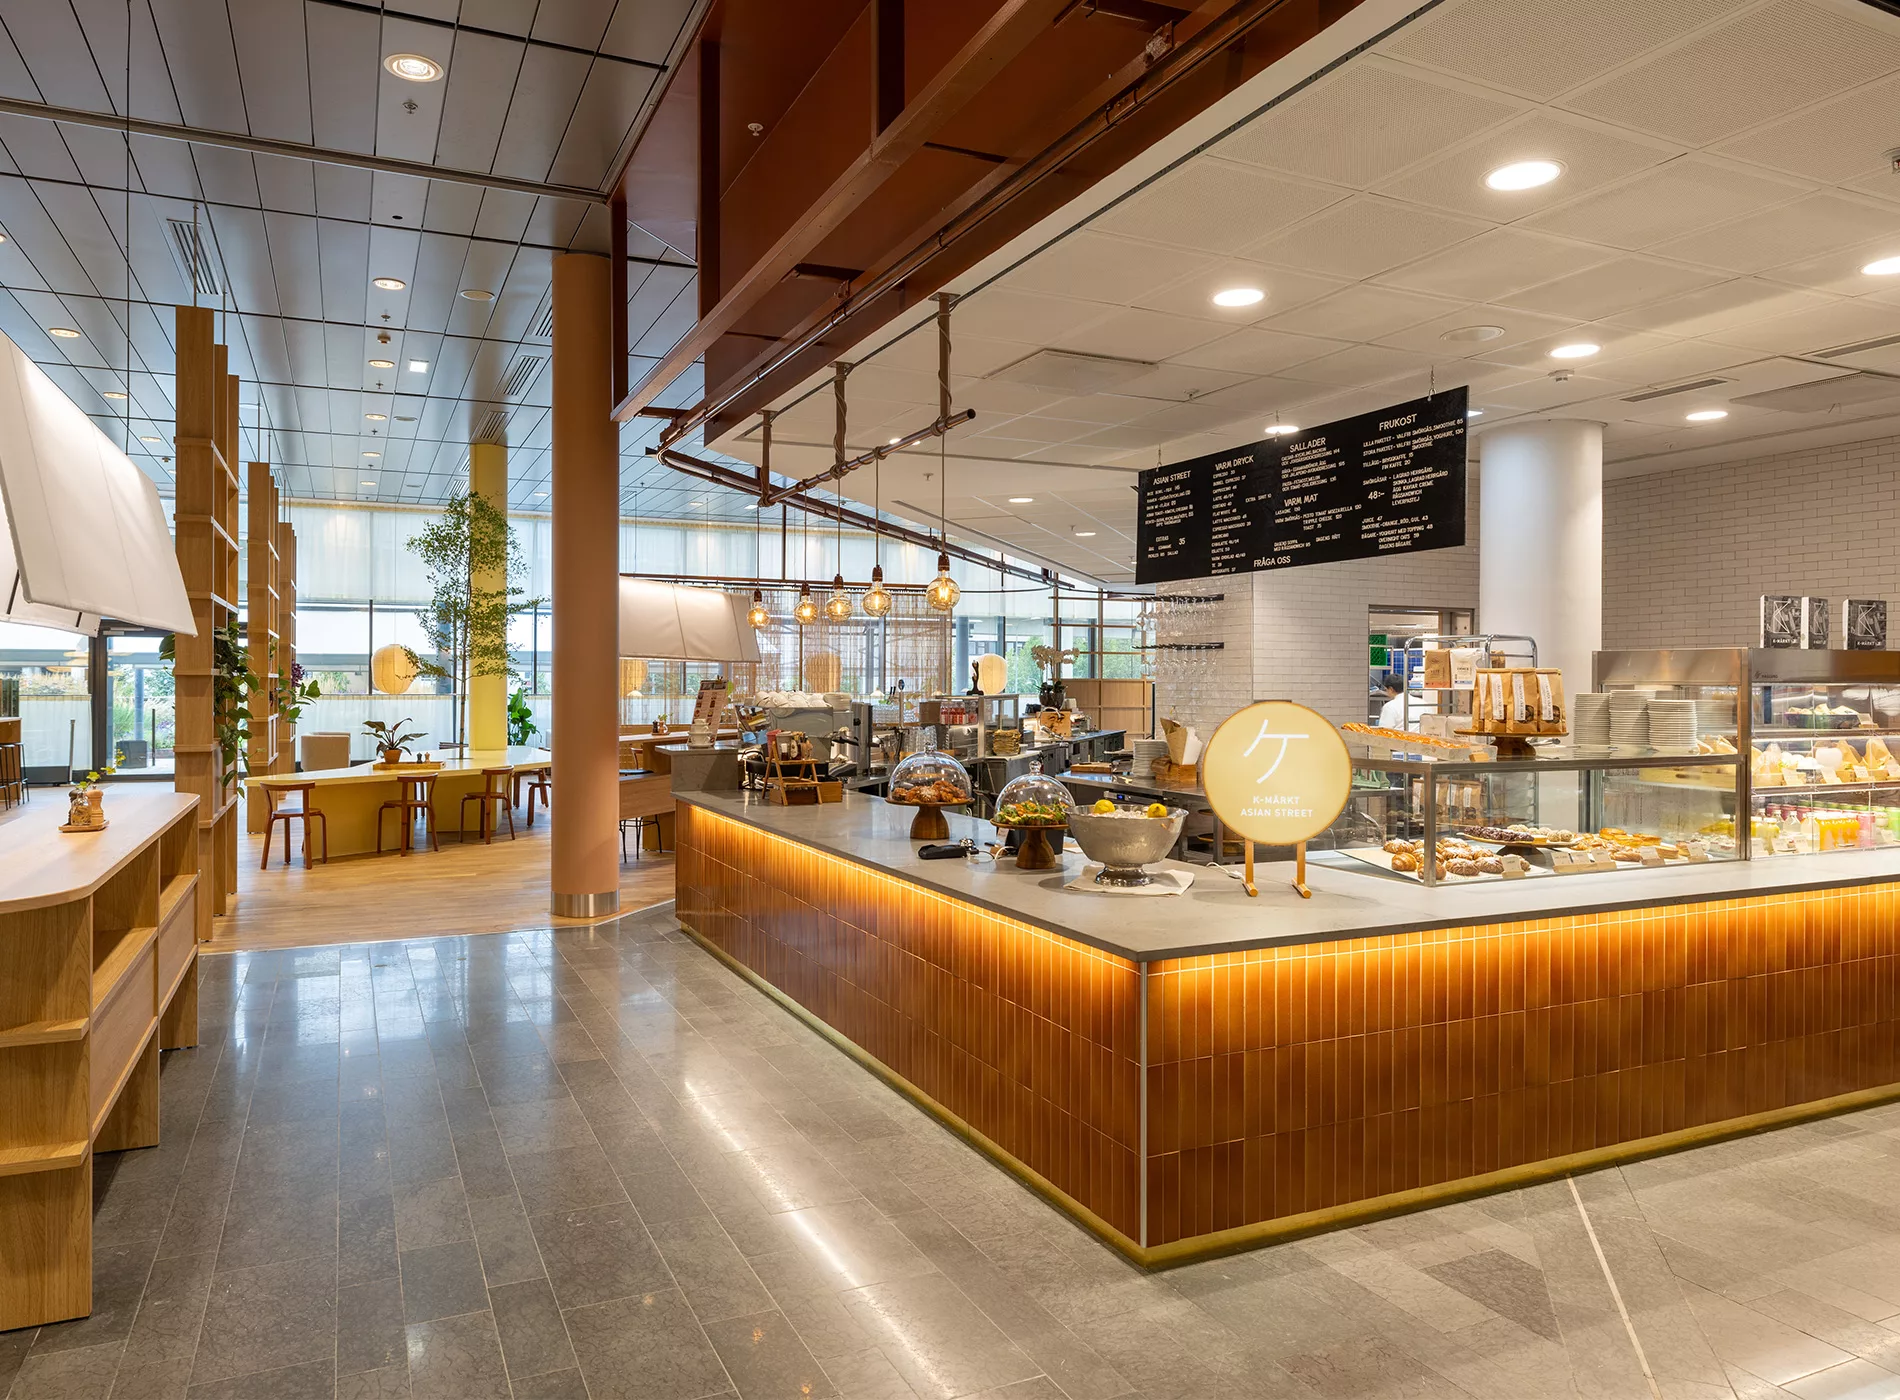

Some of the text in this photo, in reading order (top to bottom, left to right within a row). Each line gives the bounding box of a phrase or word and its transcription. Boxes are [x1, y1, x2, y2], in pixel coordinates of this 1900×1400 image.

[1379, 414, 1418, 431] FRUKOST
[1290, 437, 1326, 453] SALLADER
[1215, 455, 1254, 471] VARM DRYCK
[1390, 460, 1402, 468] KAFFE
[1153, 470, 1191, 485] ASIAN STREET
[1403, 481, 1418, 490] KAVIAR
[1284, 493, 1318, 507] VARM MAT
[1328, 506, 1352, 515] MOZZARELLA
[1254, 556, 1291, 567] FRÅGA OSS
[1240, 808, 1313, 818] ASIAN STREET
